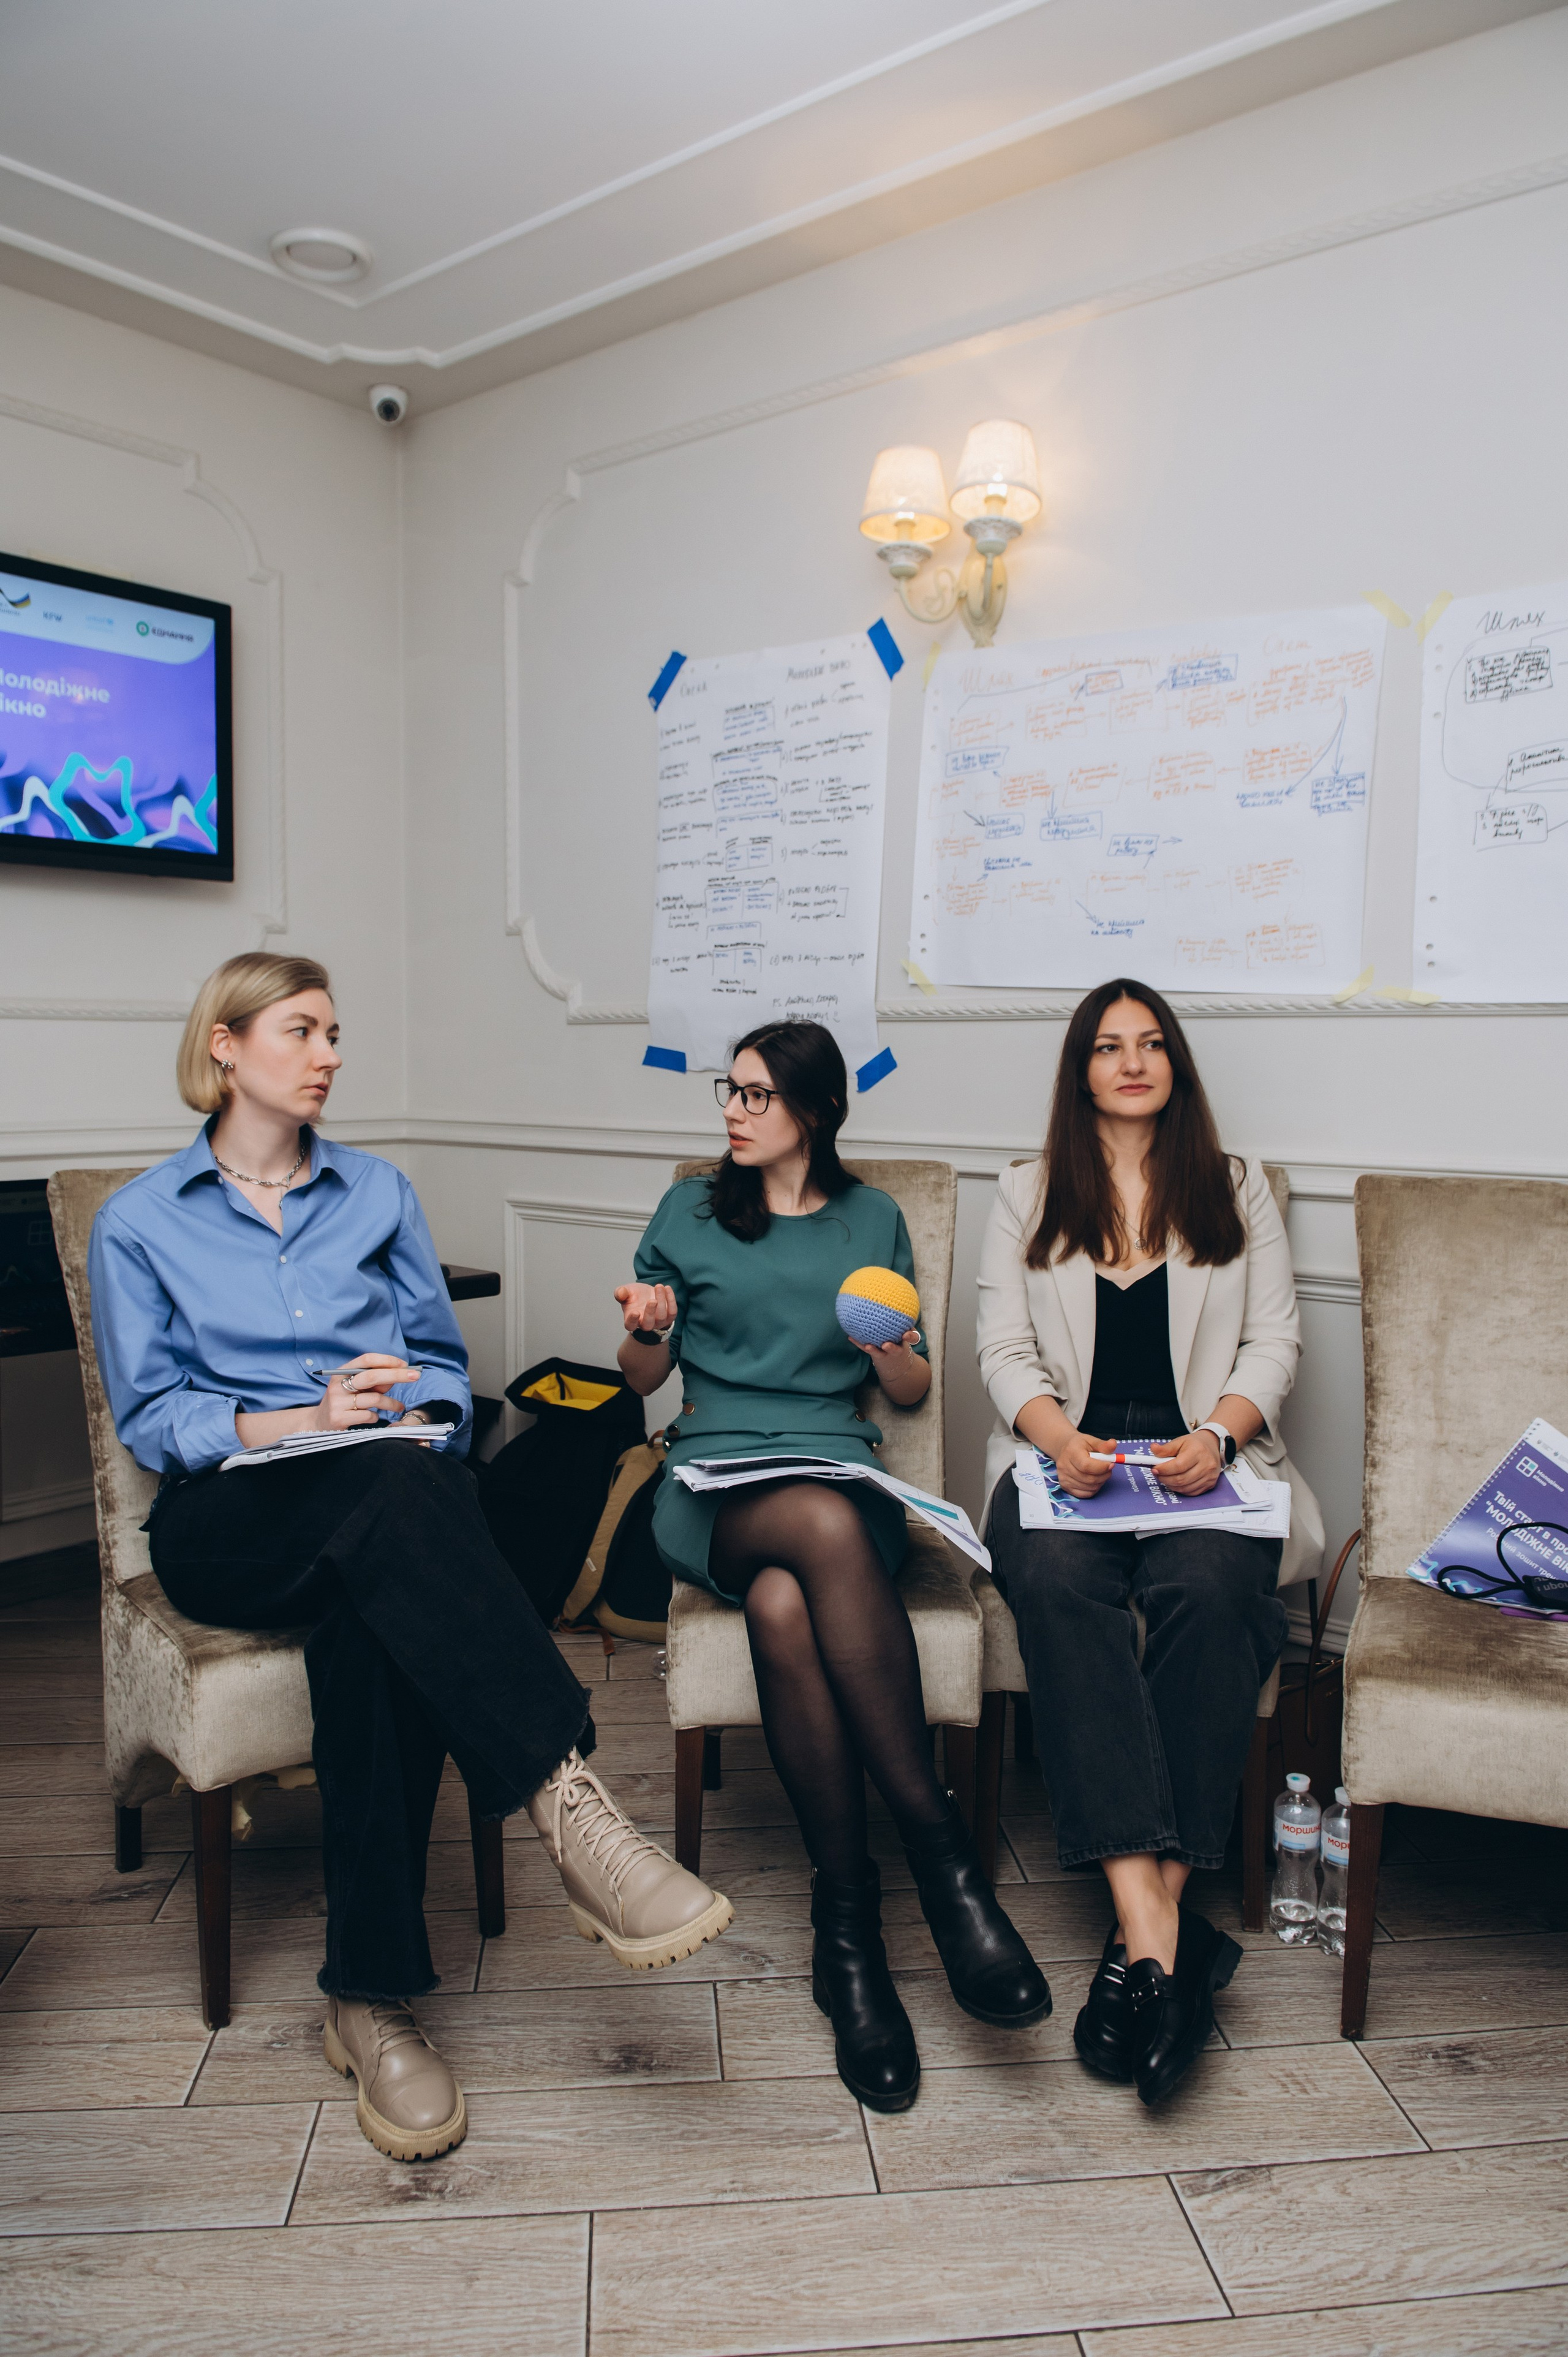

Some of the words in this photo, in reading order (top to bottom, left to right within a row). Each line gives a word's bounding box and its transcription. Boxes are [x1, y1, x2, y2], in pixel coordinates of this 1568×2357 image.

[1124, 1465, 1133, 1477] Книга
[1128, 1477, 1139, 1493] тренера
[1494, 1491, 1517, 1512] Твій
[1542, 1531, 1551, 1540] в
[1486, 1527, 1517, 1553] Робчий
[1516, 1551, 1539, 1569] зошит
